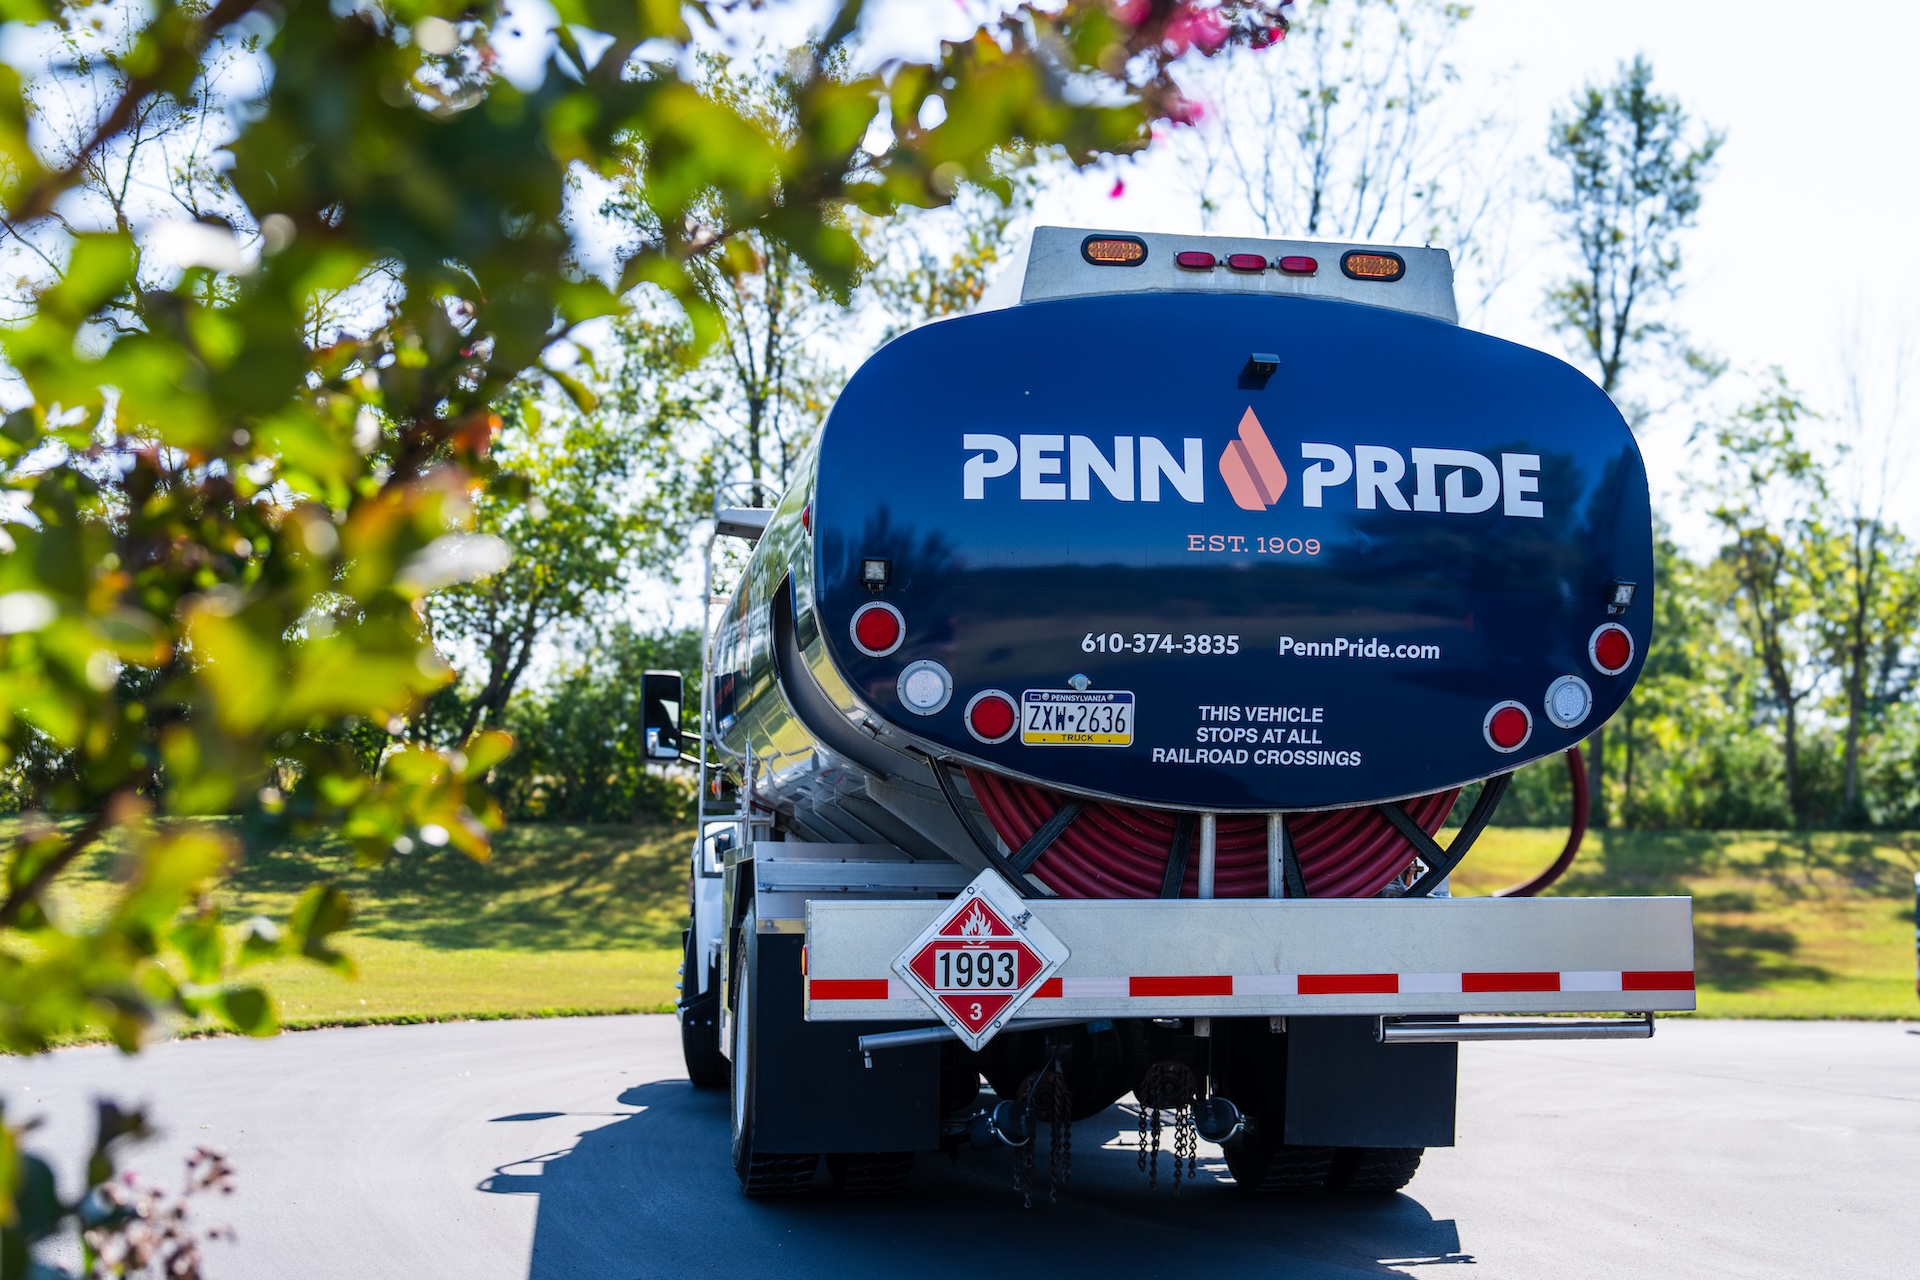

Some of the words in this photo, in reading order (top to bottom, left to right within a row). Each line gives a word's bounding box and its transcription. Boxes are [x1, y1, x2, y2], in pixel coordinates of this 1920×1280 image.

[963, 433, 1205, 503] PENN
[1301, 442, 1544, 518] PRIDE
[1187, 534, 1249, 553] EST.
[1256, 536, 1321, 556] 1909
[1081, 633, 1240, 655] 610-374-3835
[1279, 636, 1440, 660] PennPride.com
[1050, 694, 1107, 703] PENNSYLVANIA
[1198, 705, 1241, 722] THIS
[1244, 706, 1324, 723] VEHICLE
[1061, 734, 1094, 742] TRUCK
[1196, 727, 1258, 744] STOPS
[1261, 728, 1285, 744] AT
[1286, 729, 1323, 745] ALL
[1152, 748, 1249, 765] RAILROAD
[1253, 750, 1362, 767] CROSSINGS
[939, 952, 1015, 988] 1993
[969, 1002, 983, 1021] 3
